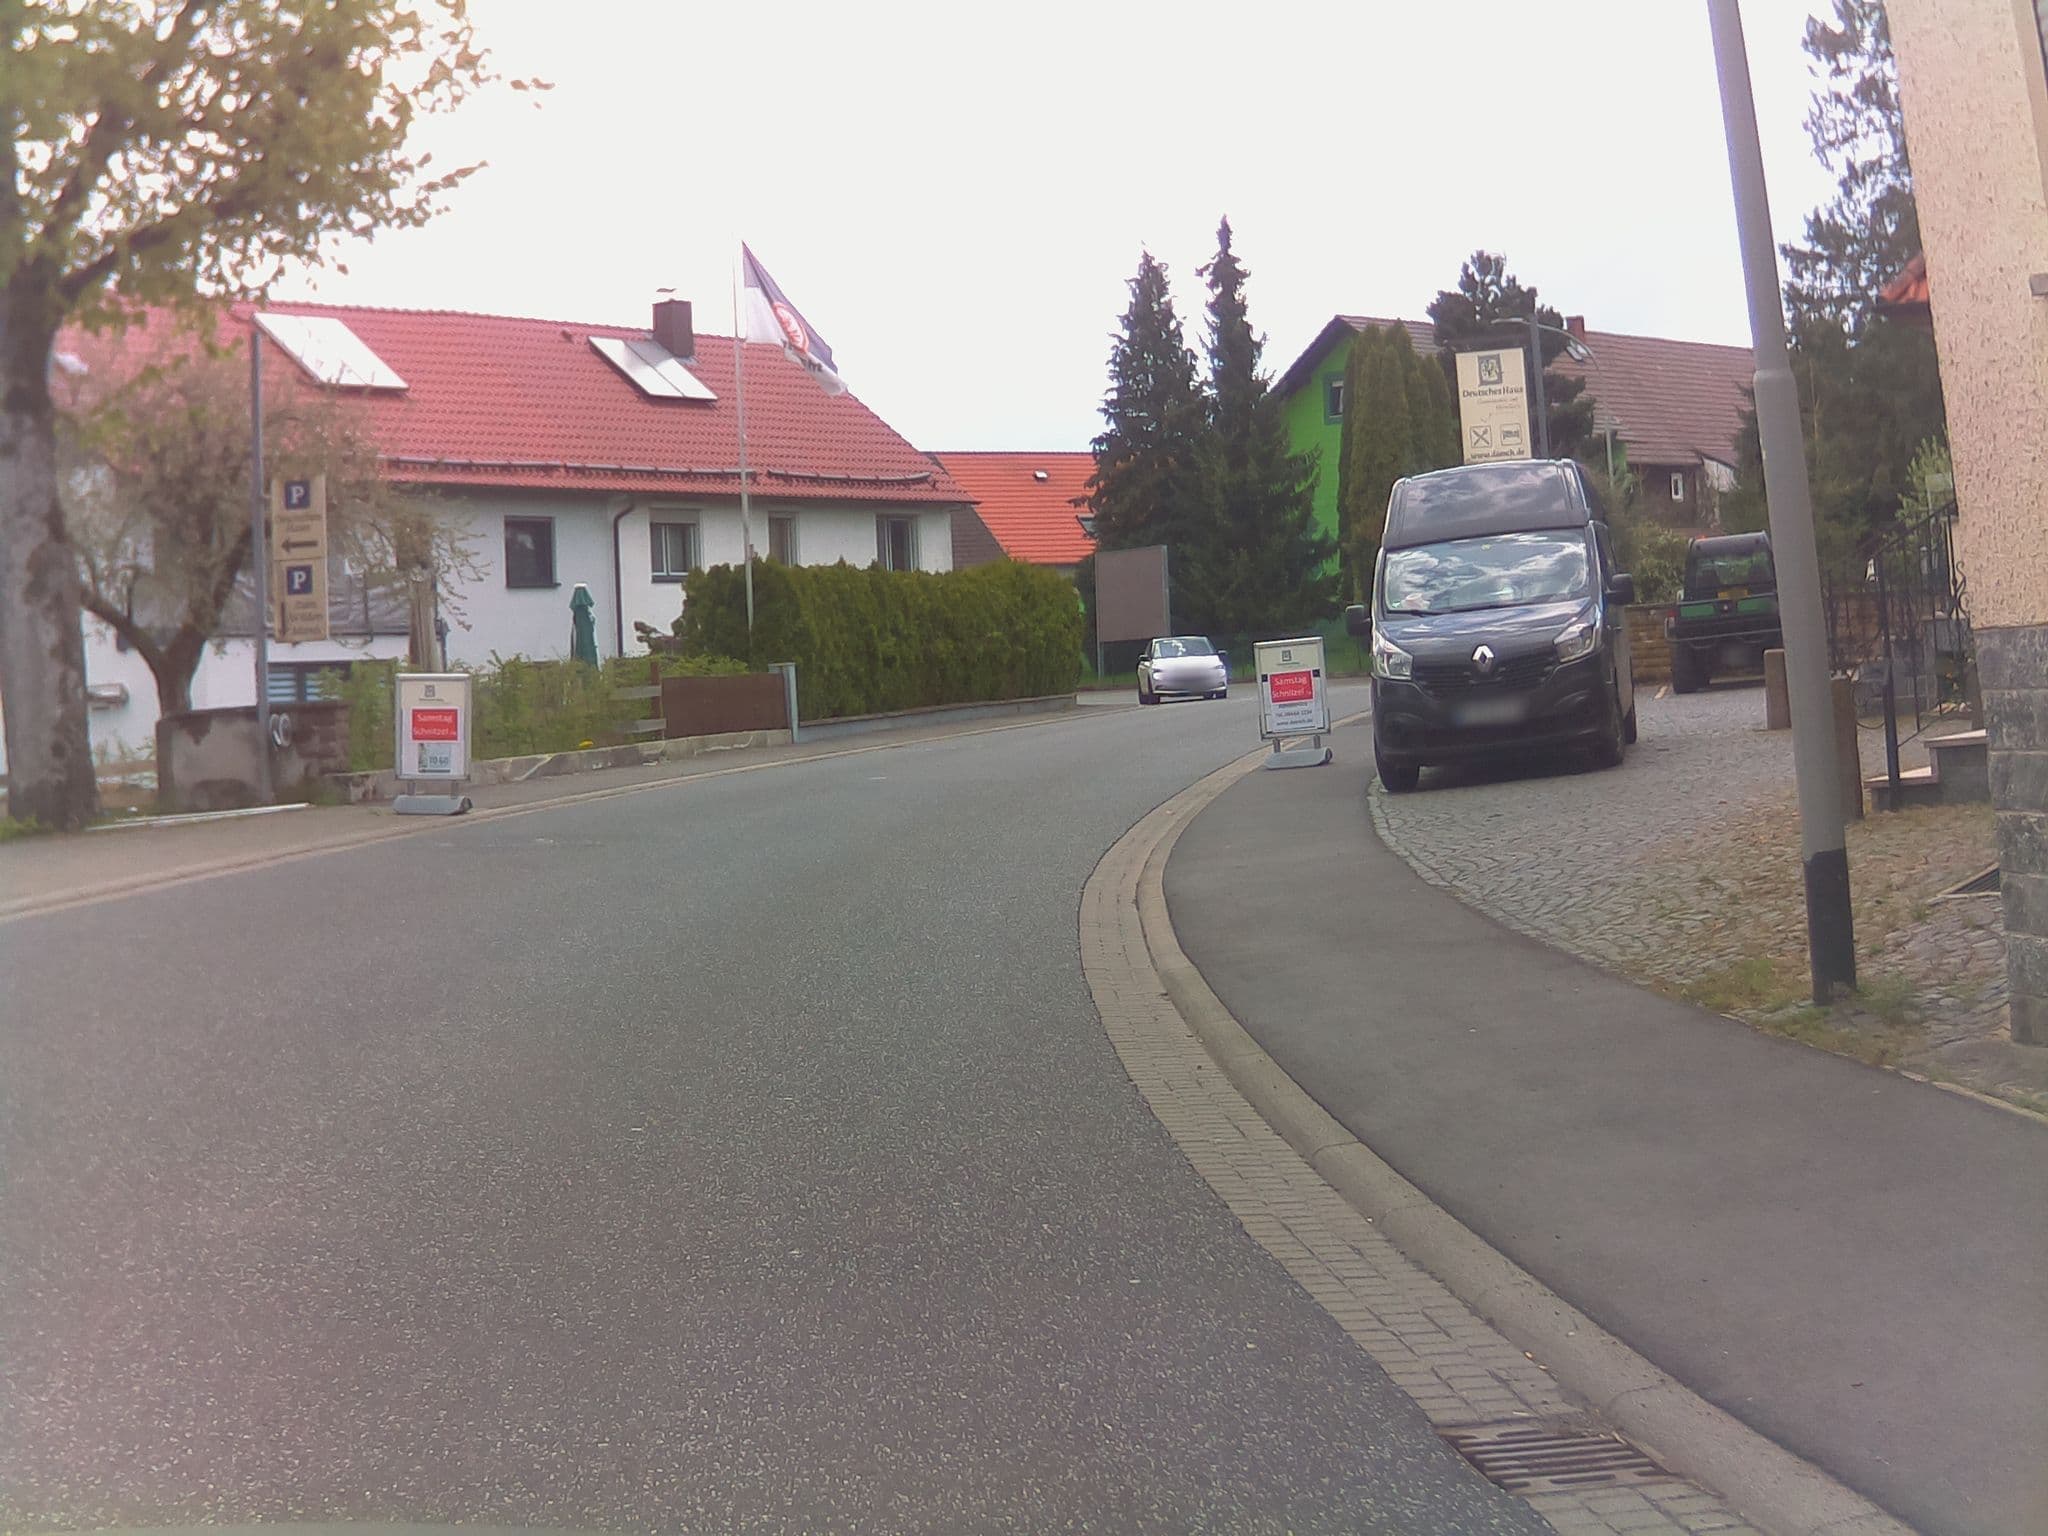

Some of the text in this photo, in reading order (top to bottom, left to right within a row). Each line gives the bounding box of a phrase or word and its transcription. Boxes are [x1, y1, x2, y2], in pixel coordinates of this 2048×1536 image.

[1462, 386, 1524, 398] Deutsches Haus
[291, 486, 305, 504] P
[293, 571, 306, 590] P
[1274, 676, 1308, 686] Samstag
[1272, 688, 1305, 698] Schnitzel
[416, 713, 453, 723] Samstag
[413, 727, 449, 736] Schnitzel
